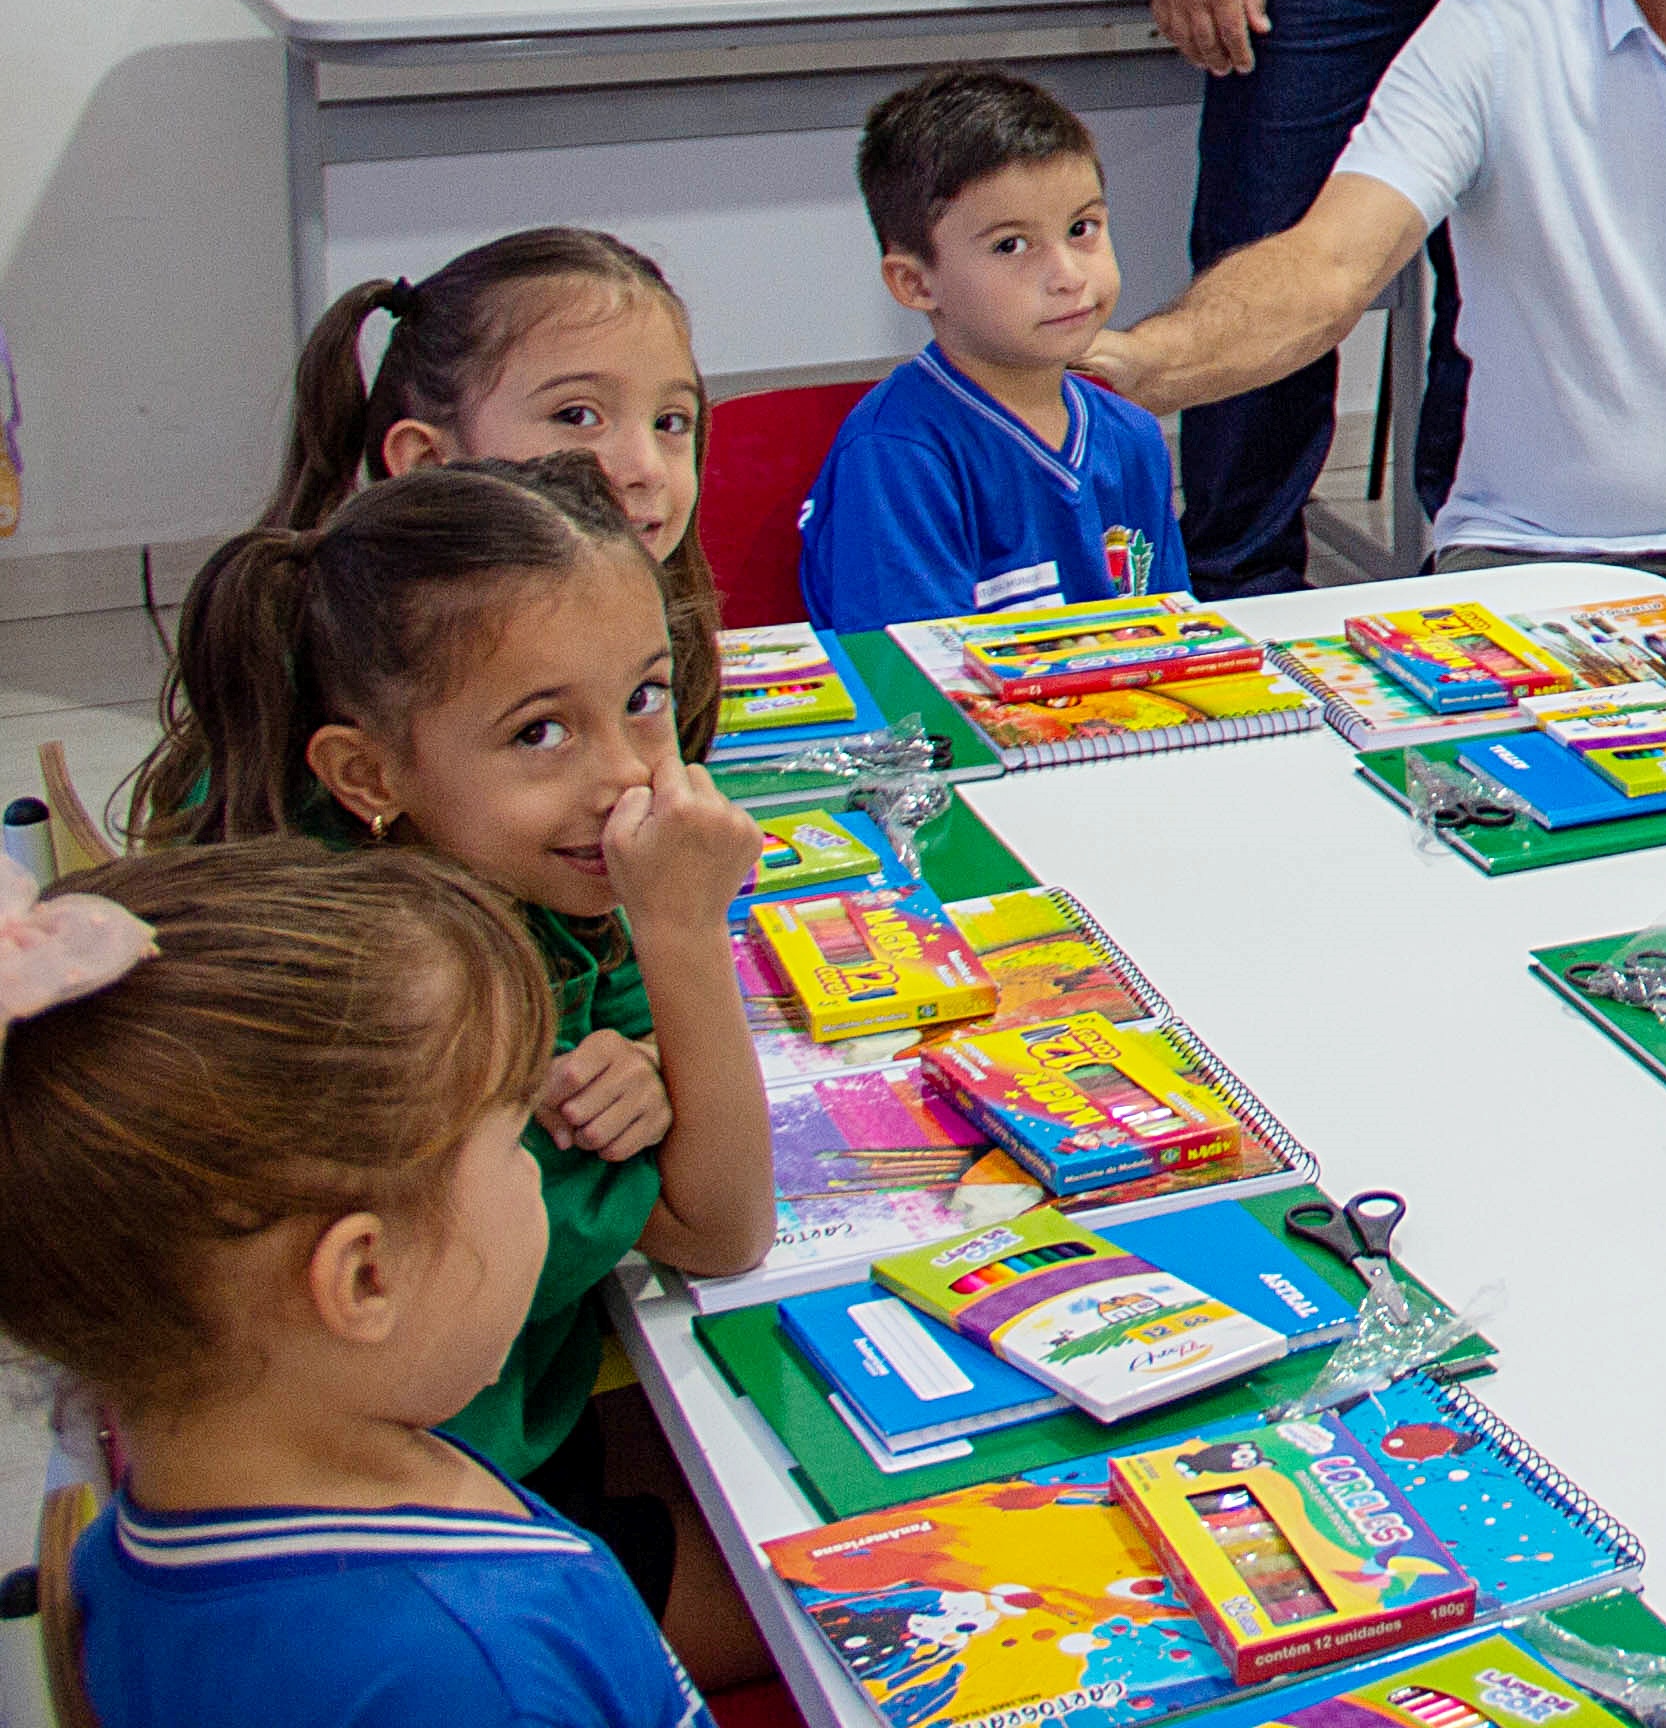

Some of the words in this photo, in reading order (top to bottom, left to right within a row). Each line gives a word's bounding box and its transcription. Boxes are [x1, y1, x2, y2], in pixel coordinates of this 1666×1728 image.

[839, 961, 900, 994] 12
[1027, 1037, 1094, 1071] 12
[1259, 1271, 1320, 1320] ASTRAL
[811, 1519, 932, 1559] PanAmericana
[1254, 1640, 1309, 1667] contém
[1314, 1634, 1332, 1652] 12
[1334, 1617, 1401, 1647] unidades
[1430, 1599, 1465, 1623] 180g
[1486, 1686, 1553, 1724] COR
[1540, 1692, 1577, 1713] DE
